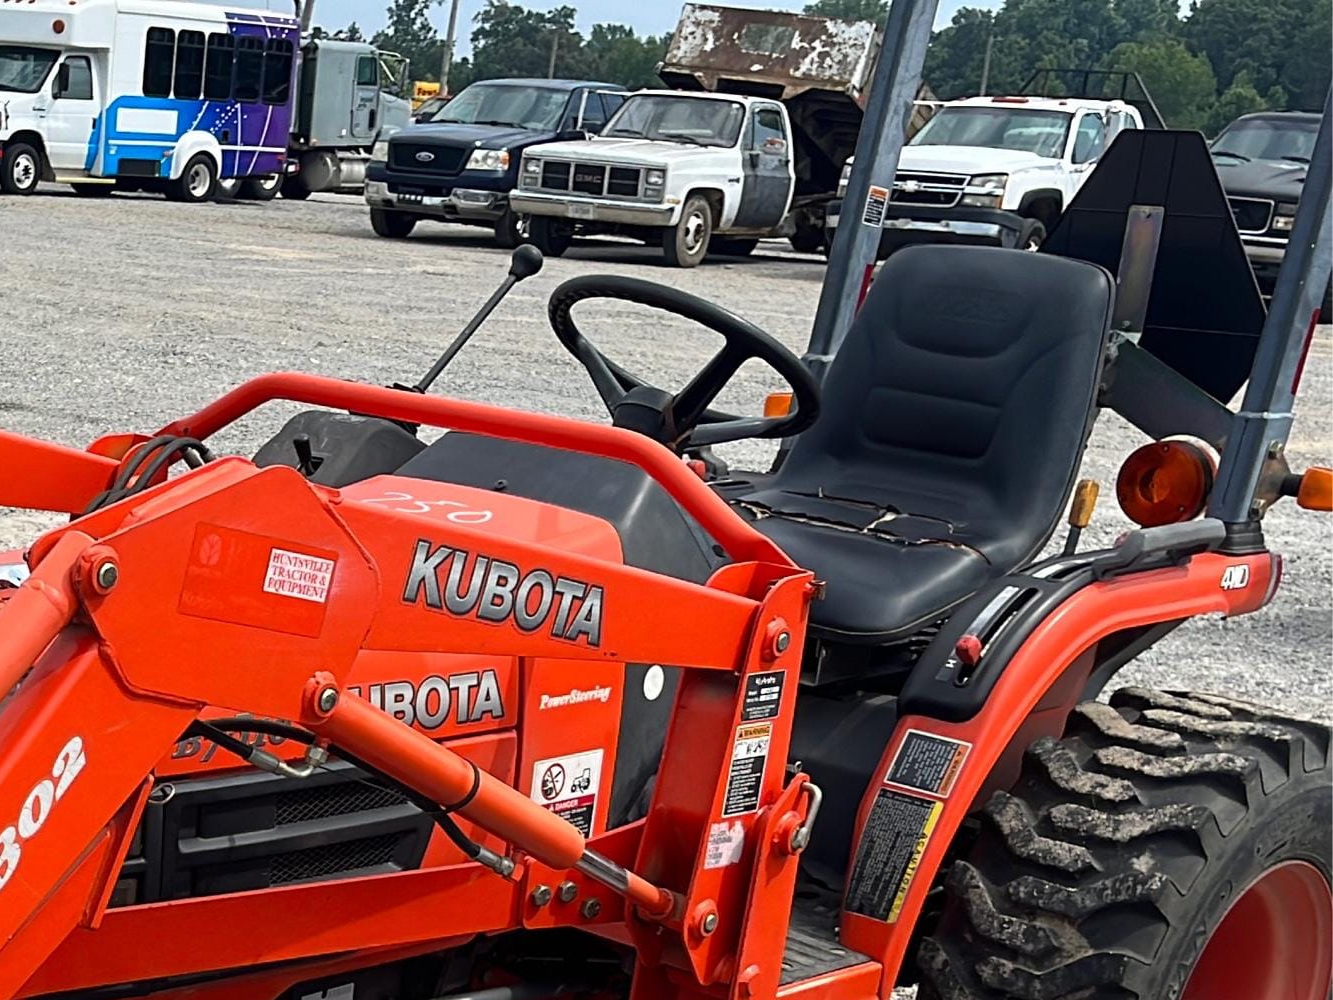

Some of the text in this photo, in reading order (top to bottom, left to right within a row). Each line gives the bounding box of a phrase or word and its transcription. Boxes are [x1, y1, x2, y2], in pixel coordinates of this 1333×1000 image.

[272, 552, 333, 574] HUNTSVILLE
[267, 576, 326, 599] EQUIPMENT
[271, 564, 327, 587] TRACTOR &
[1220, 564, 1249, 591] 4WD
[402, 539, 604, 648] KUBOTA
[539, 685, 612, 710] PowerSteering
